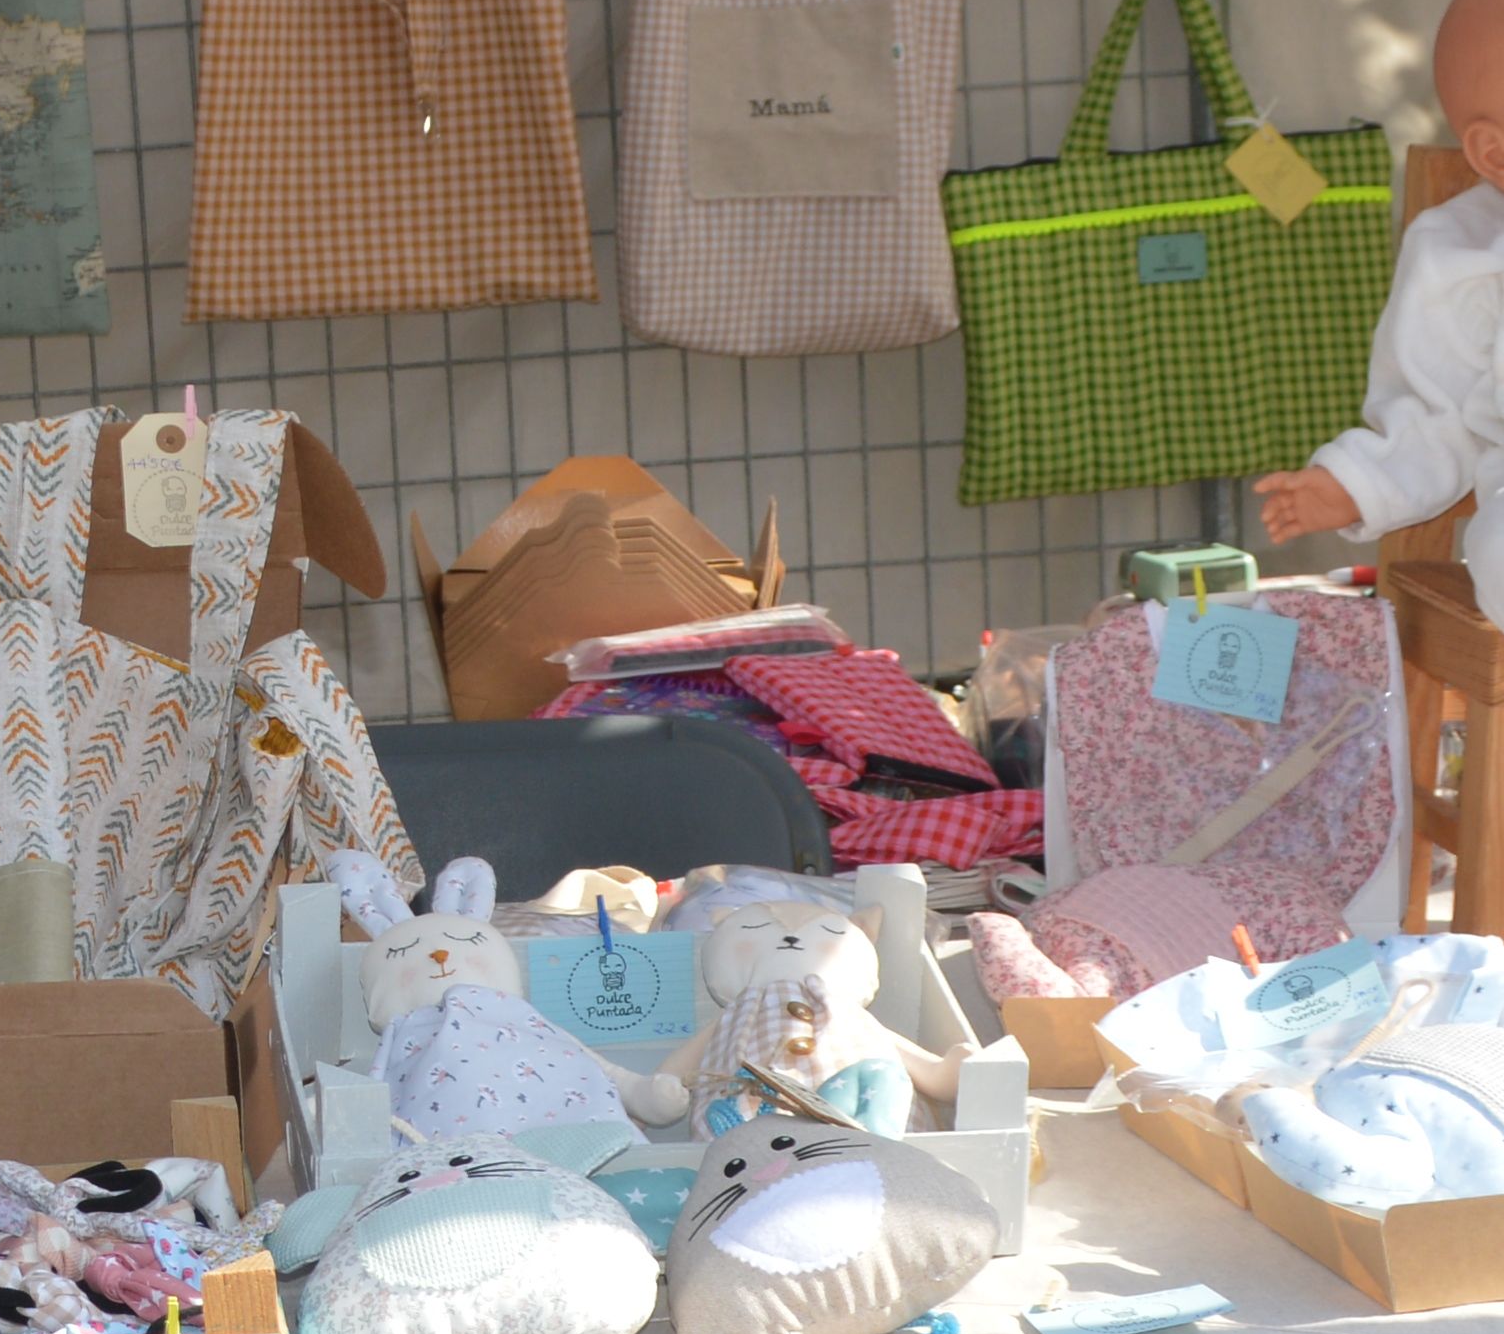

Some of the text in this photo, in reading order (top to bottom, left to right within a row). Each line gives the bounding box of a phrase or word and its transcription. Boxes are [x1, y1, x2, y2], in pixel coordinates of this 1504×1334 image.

[748, 94, 832, 118] Mamá
[595, 991, 632, 1006] Dulce
[586, 1004, 644, 1019] Puntada
